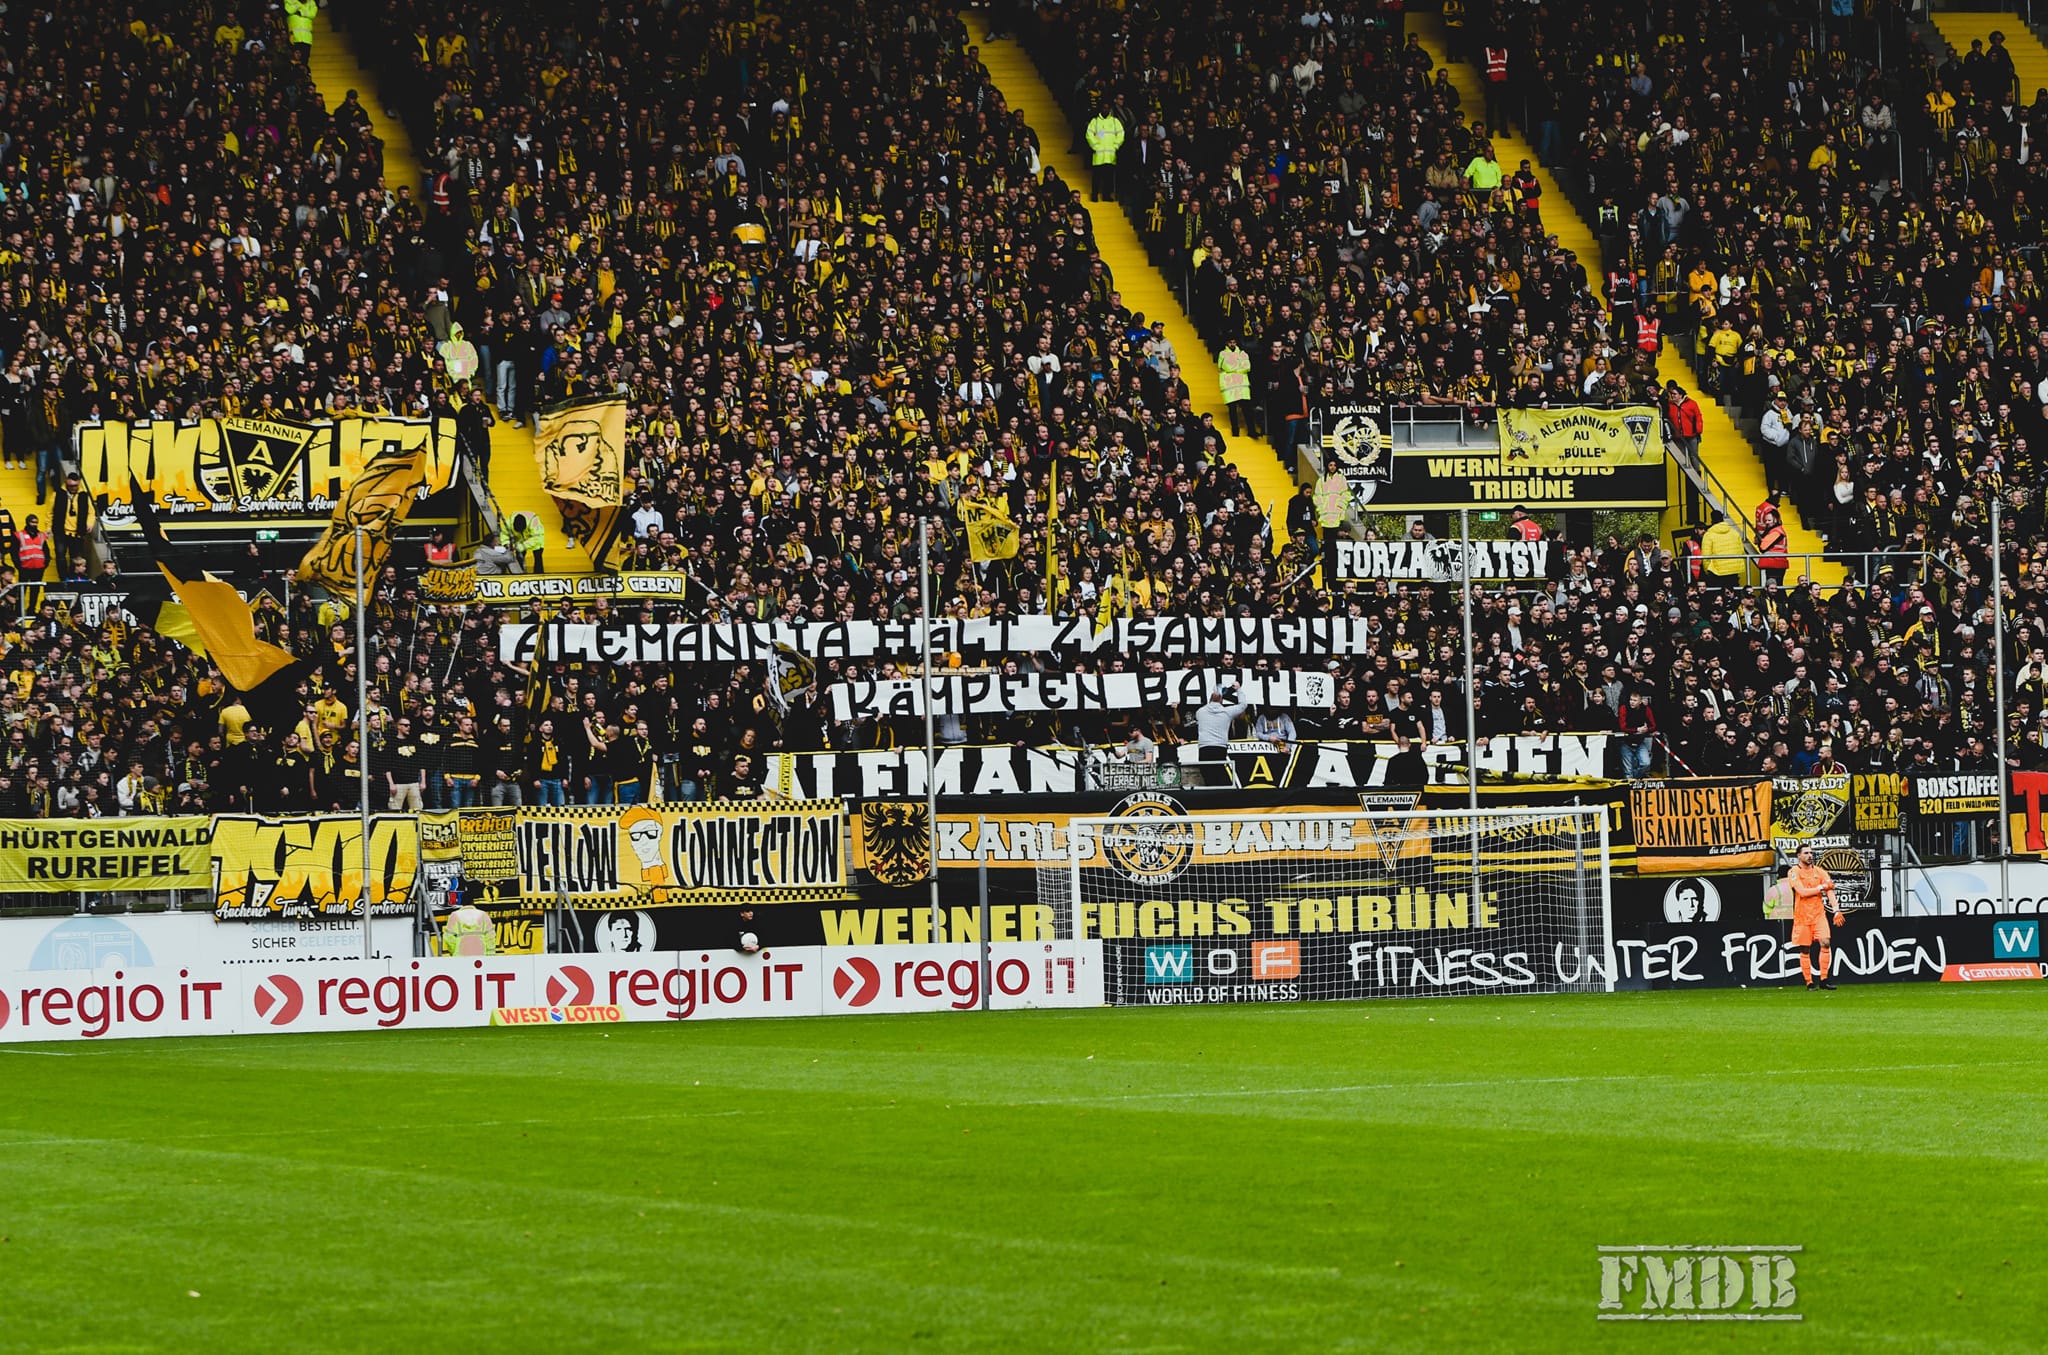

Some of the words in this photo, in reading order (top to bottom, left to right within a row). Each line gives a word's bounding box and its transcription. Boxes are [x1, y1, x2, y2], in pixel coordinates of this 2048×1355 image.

[1330, 405, 1380, 415] RABAUKEN
[227, 417, 302, 441] ALEMANNIA
[1540, 415, 1619, 438] ALEMANNIA'S
[1573, 431, 1589, 441] AU
[1338, 467, 1388, 476] QUISGRANA
[1470, 477, 1575, 499] TRIBÜNE
[212, 500, 232, 512] und
[1336, 541, 1427, 578] FORZA
[1474, 541, 1549, 578] ATSV
[509, 577, 572, 596] AACHEN
[578, 576, 622, 593] ALLES
[630, 575, 682, 594] GEBEN!
[848, 675, 1106, 718] KÄMPFEN
[1802, 777, 1846, 791] STADT
[1854, 773, 1899, 797] PYRO
[1917, 776, 1999, 798] BOXSTAFFE
[1855, 802, 1898, 820] KEIN
[1920, 799, 1942, 814] 520
[460, 817, 512, 832] FREIHEIT
[1, 828, 210, 850] HÜRTGENWALD
[936, 821, 1096, 861] KARLS
[1201, 820, 1356, 855] BANDE
[1775, 838, 1799, 850] UND
[1801, 836, 1850, 849] VEREIN
[517, 820, 619, 893] YELLOW
[672, 814, 840, 888] CONNECTION
[28, 854, 190, 879] RUREIFEL
[215, 901, 271, 919] Aachener
[325, 900, 348, 915] und
[351, 898, 416, 916] Sortverein
[820, 904, 1056, 945] WERNER
[1081, 899, 1250, 938] FUCHS
[1264, 887, 1500, 935] TRIBÜNE
[300, 920, 360, 932] BESTELLT.
[252, 937, 297, 949] SICHER
[1998, 927, 2034, 953] W
[1350, 942, 1535, 986] FITNESS
[1971, 965, 2034, 978] camcontrol
[610, 954, 747, 1019] regio
[763, 951, 804, 1002] iT
[895, 943, 1030, 1010] regio
[21, 970, 165, 1038] regio
[180, 969, 223, 1021] iT
[319, 961, 459, 1028] regio
[474, 960, 516, 1011] iT
[1147, 987, 1203, 1004] WORLD
[1208, 986, 1229, 1001] OF
[1236, 984, 1298, 1000] FITNESS
[500, 1008, 548, 1024] WEST
[564, 1006, 621, 1022] LOTTO
